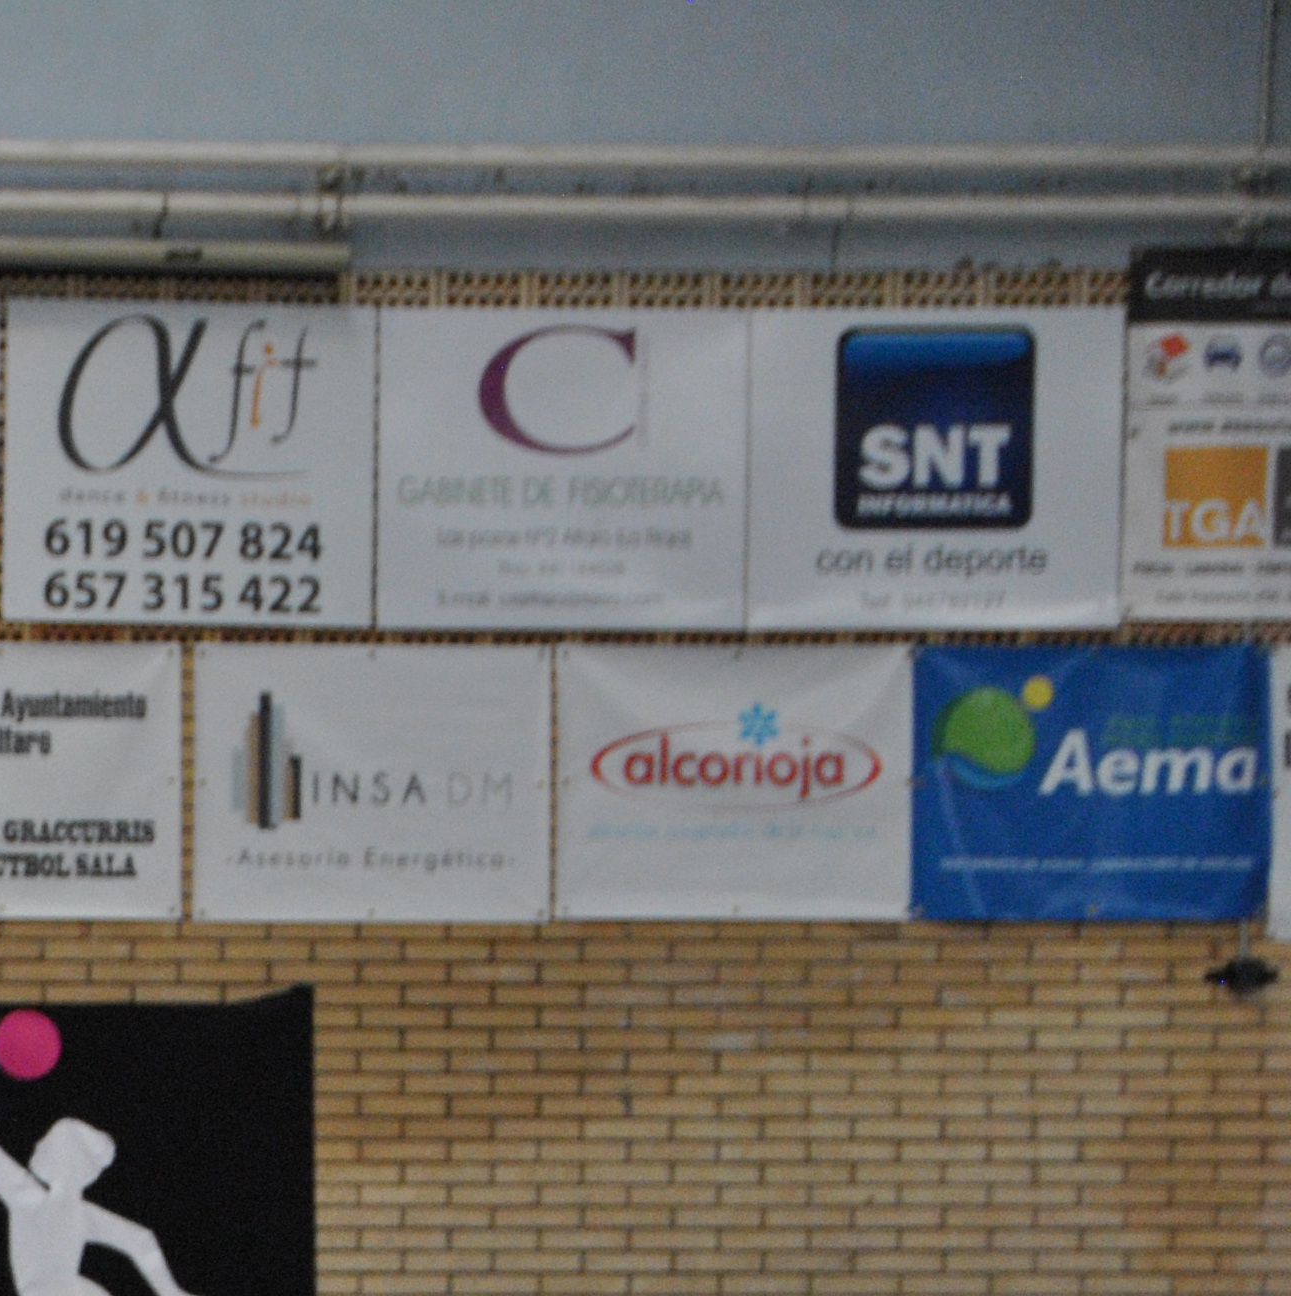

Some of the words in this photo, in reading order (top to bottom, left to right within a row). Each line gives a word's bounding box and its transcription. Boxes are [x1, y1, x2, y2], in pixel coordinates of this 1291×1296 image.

[857, 423, 1013, 490] SNT
[45, 518, 127, 557] 619
[143, 520, 225, 559] 507
[239, 521, 322, 561] 824
[1165, 499, 1269, 542] TGA
[816, 549, 873, 574] con
[885, 543, 914, 574] el
[923, 545, 1049, 579] deporte
[44, 570, 126, 608] 657
[143, 572, 223, 611] 315
[238, 574, 322, 613] 422
[1, 690, 147, 722] Ayuntamiento
[1039, 727, 1257, 796] Aema
[4, 819, 155, 844] GRACCURRIS
[75, 853, 136, 878] SALA
